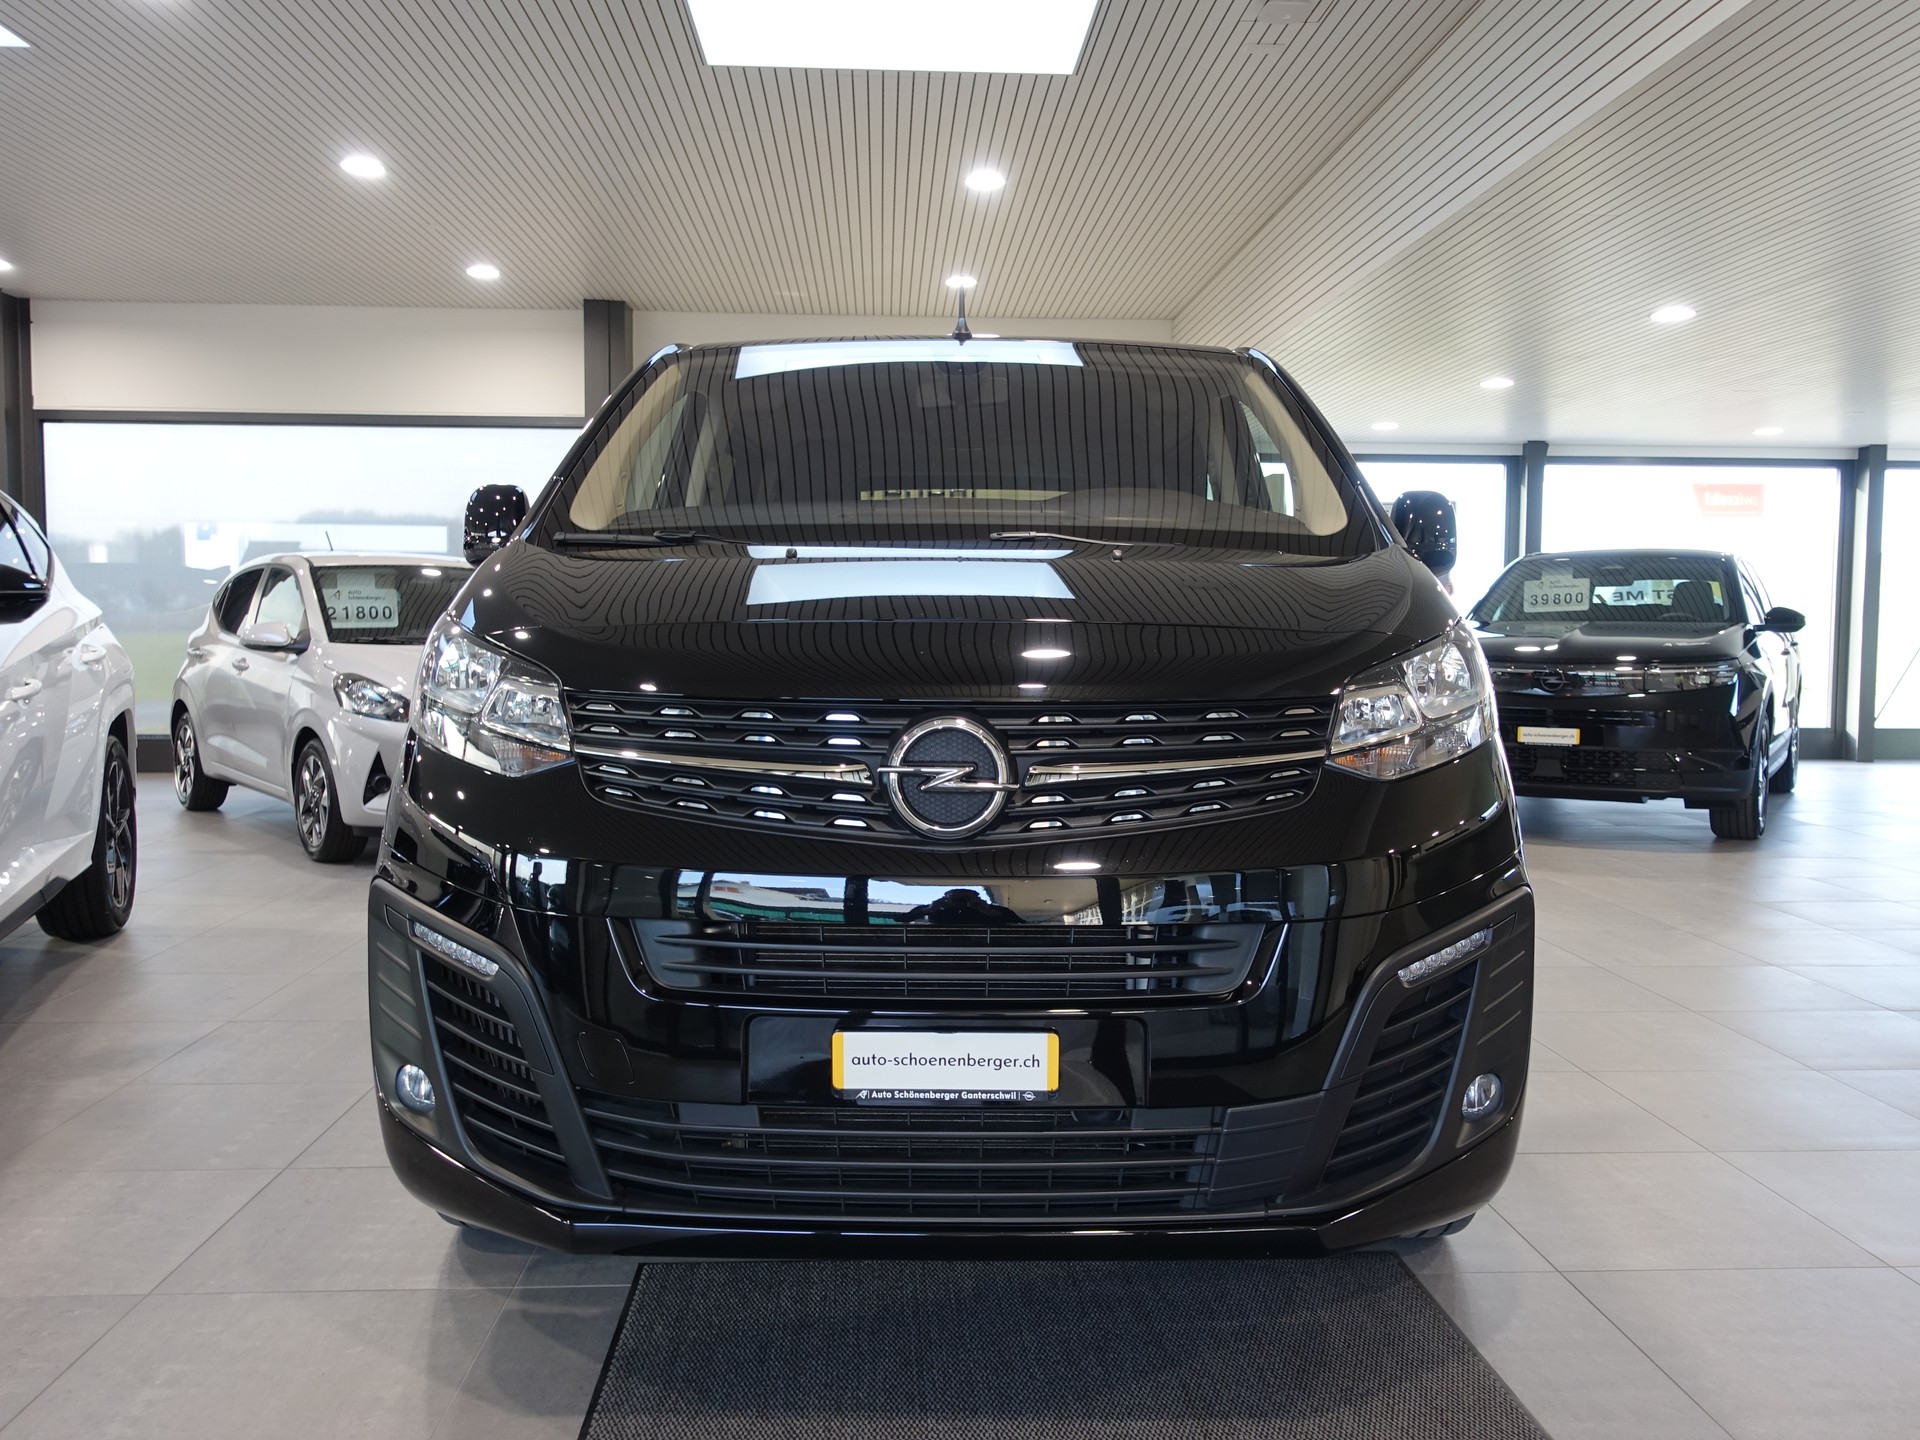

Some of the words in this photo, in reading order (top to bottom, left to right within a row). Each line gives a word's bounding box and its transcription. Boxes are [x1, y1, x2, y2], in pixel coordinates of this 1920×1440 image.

[1530, 592, 1584, 606] 39800
[327, 606, 393, 620] 21800
[851, 1053, 1040, 1070] auto-schoenenberger.ch
[871, 1090, 893, 1099] Auto
[894, 1090, 960, 1100] Schönenberger
[961, 1091, 1017, 1100] Ganterschwil
